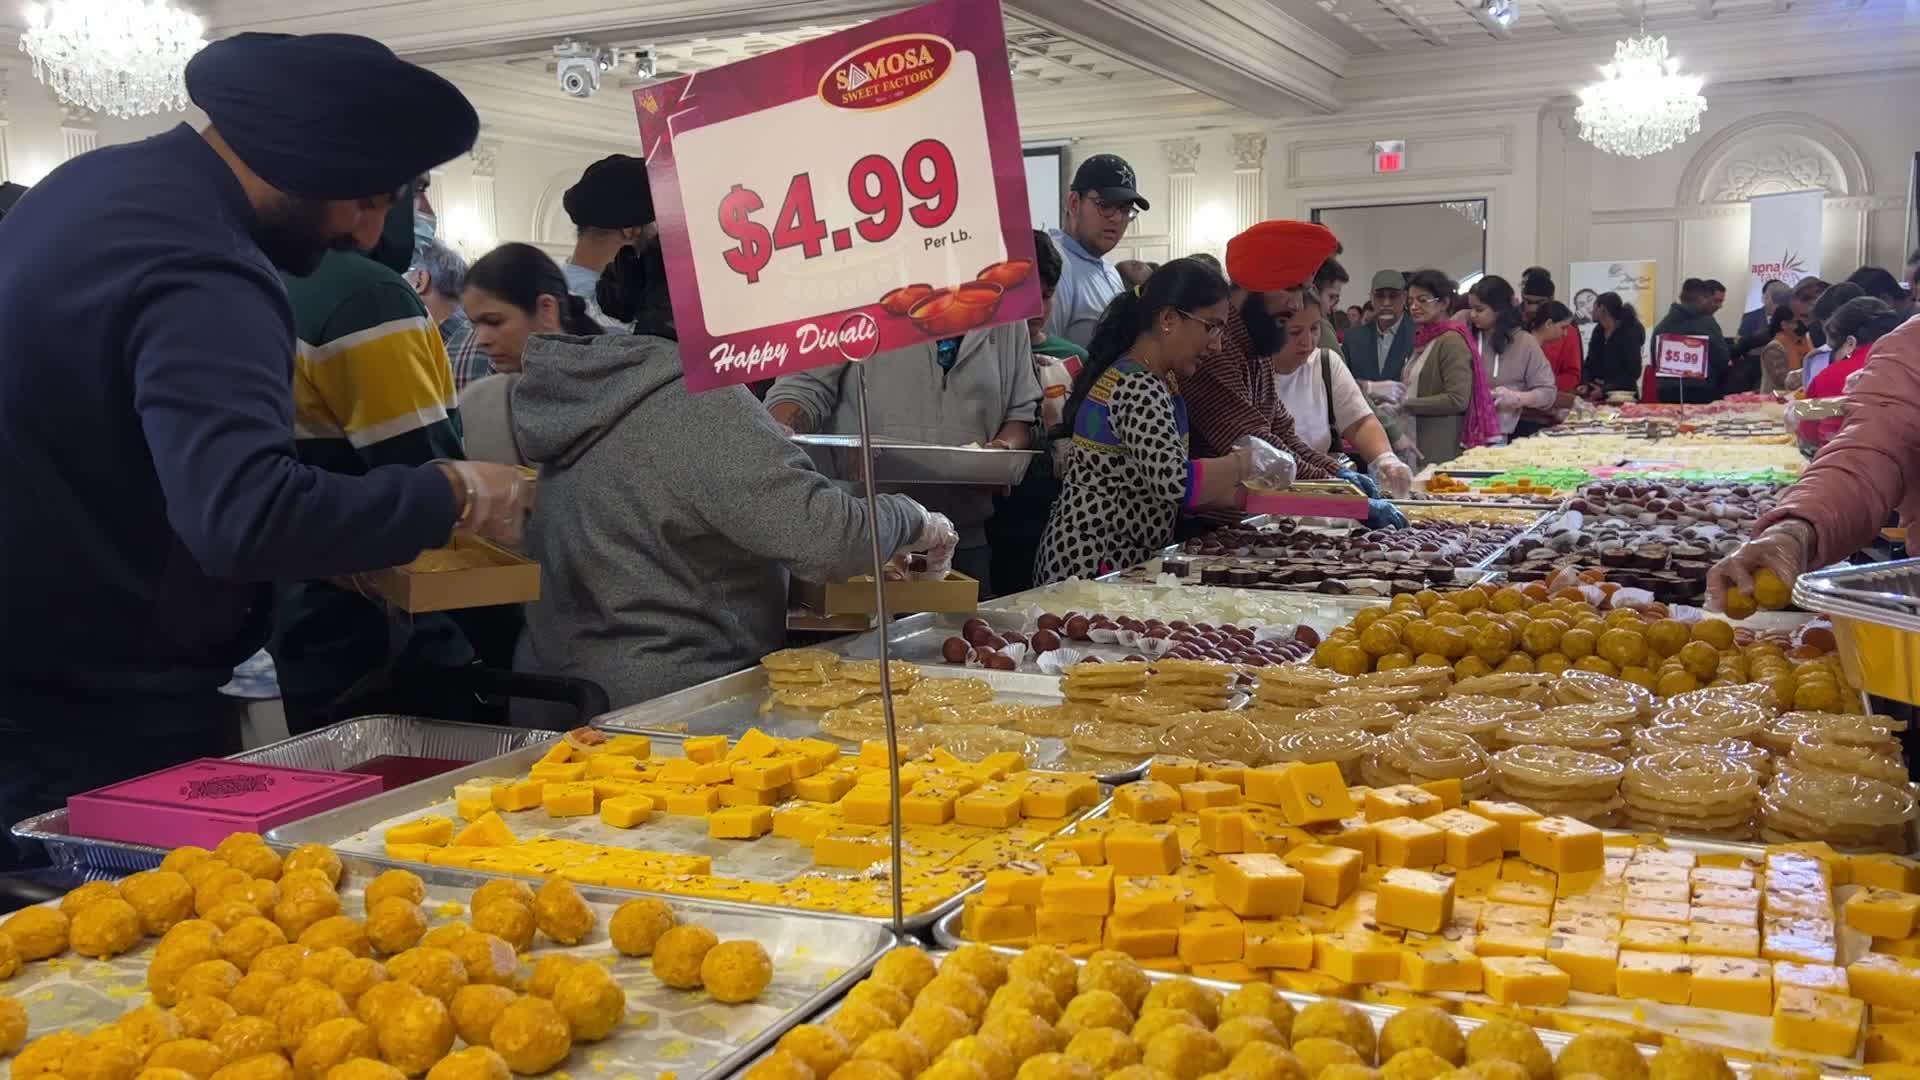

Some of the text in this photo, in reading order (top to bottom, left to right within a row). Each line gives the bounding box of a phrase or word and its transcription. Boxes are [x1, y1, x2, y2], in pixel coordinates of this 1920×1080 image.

[836, 44, 935, 91] SAMOSA
[842, 83, 882, 104] SWEET
[882, 67, 935, 93] FACTORY
[718, 138, 959, 284] $4.99
[923, 228, 973, 252] Per Lb.
[1752, 263, 1780, 276] apna
[709, 318, 877, 374] Happy Diwali
[1665, 348, 1699, 364] $5.99
